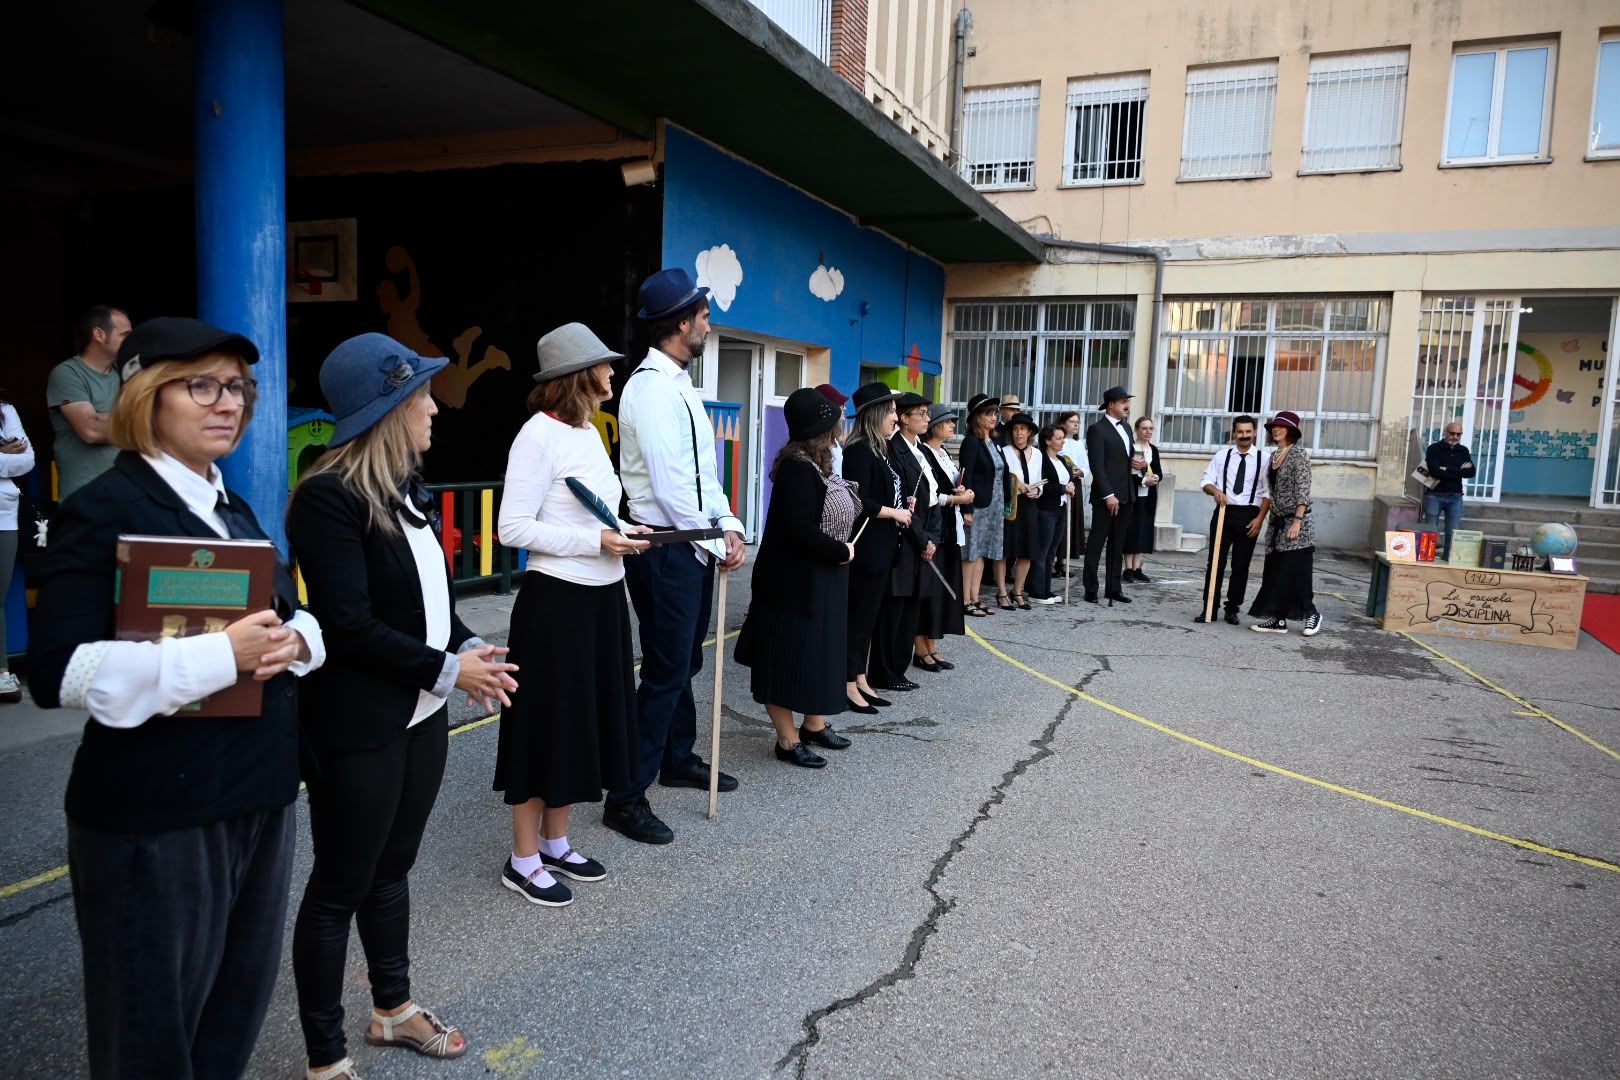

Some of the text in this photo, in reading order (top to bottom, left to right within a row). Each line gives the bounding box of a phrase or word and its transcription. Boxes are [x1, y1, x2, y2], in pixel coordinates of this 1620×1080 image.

[1470, 573, 1495, 584] 1927
[1442, 588, 1513, 603] La escuela
[1481, 601, 1492, 609] la
[1441, 604, 1511, 622] DISCIPLINA
